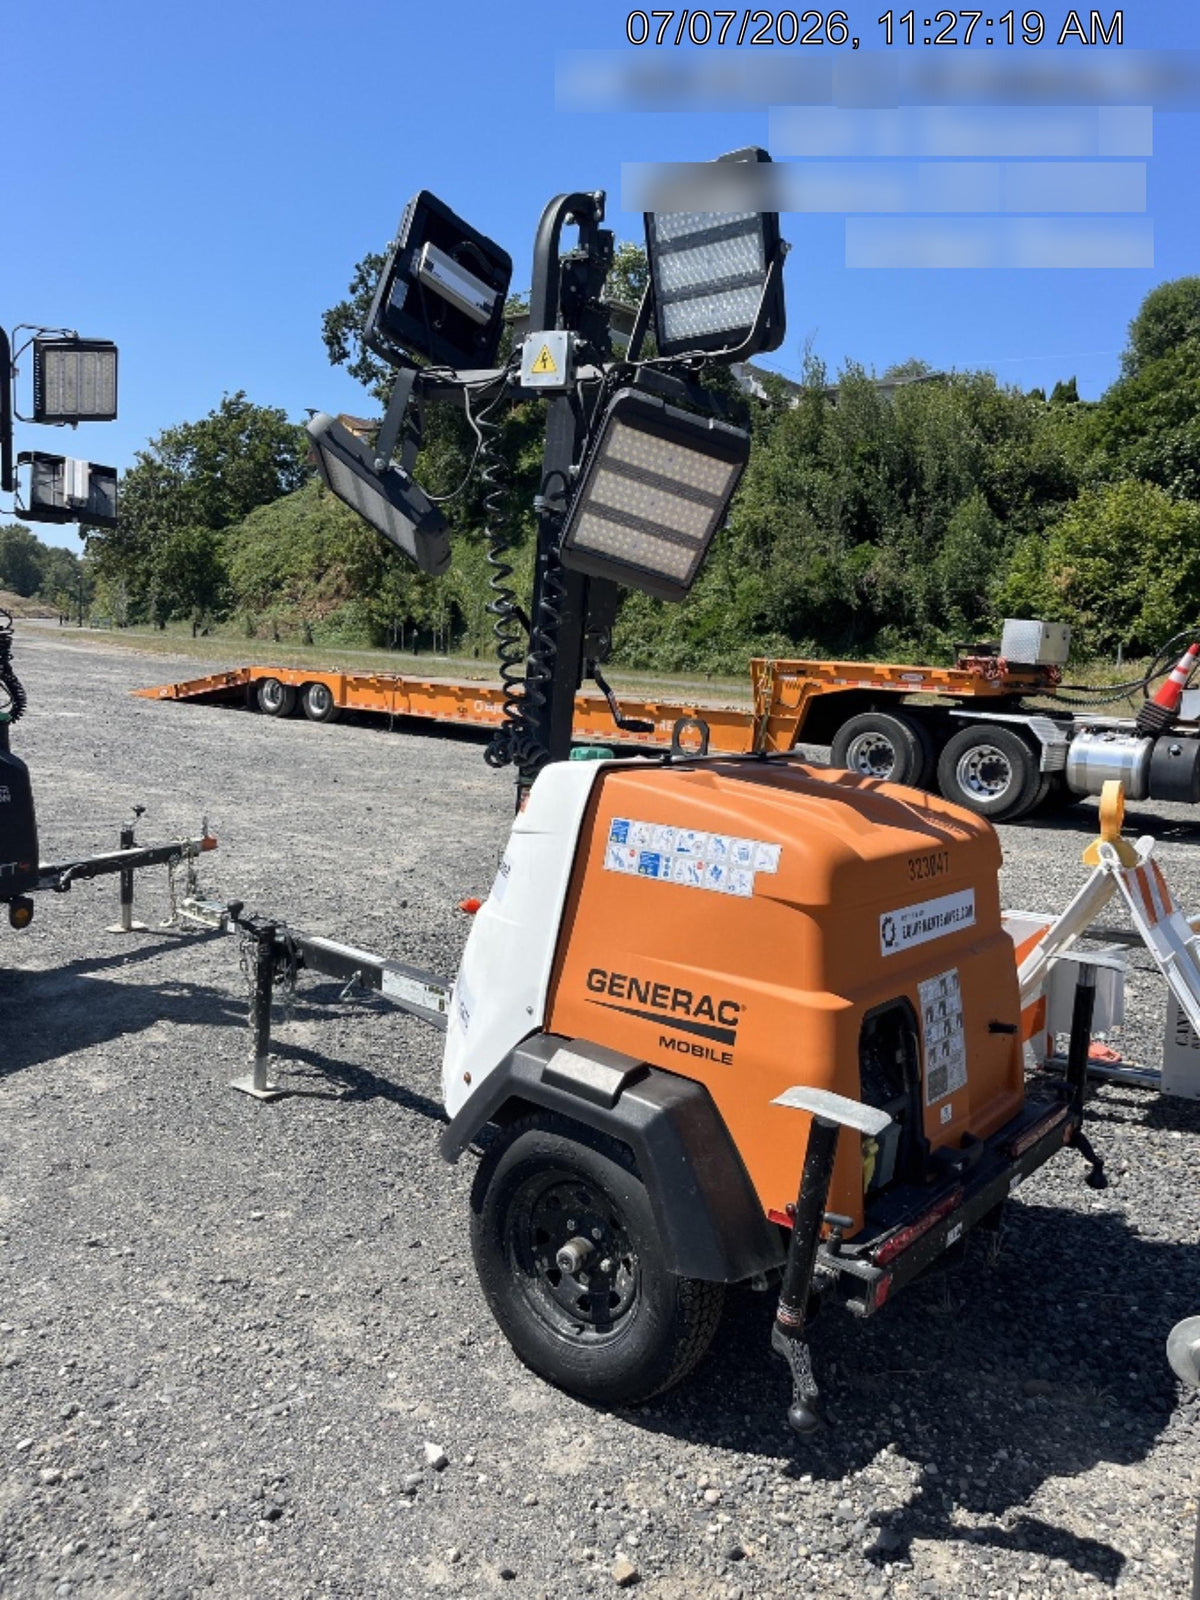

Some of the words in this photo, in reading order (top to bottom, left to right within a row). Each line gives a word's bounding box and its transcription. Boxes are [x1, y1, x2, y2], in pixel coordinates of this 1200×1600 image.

[908, 852, 949, 881] 323047
[586, 968, 740, 1026] GENERAC
[658, 1036, 734, 1066] MOBILE
